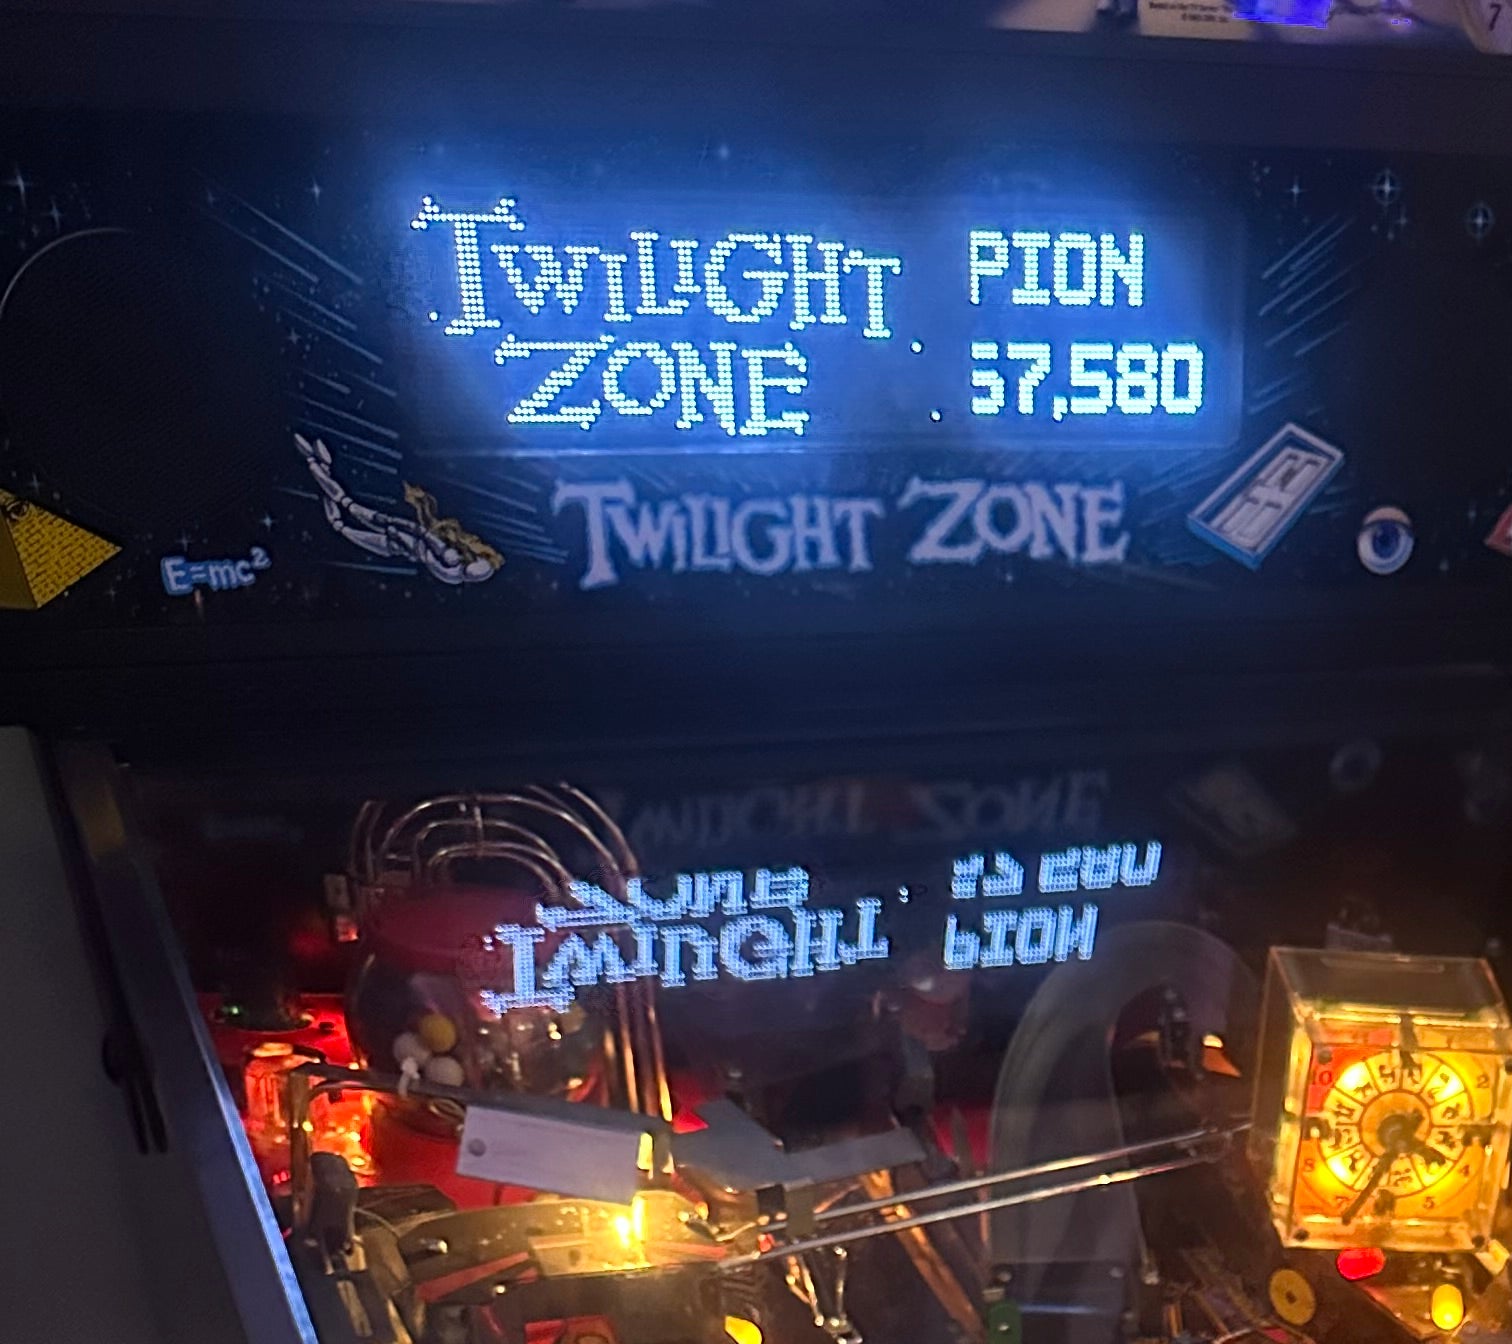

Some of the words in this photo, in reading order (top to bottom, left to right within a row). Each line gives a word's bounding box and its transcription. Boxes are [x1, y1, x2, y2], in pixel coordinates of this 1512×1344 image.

[1485, 4, 1502, 31] 7
[411, 196, 902, 338] TWILIGHT
[969, 231, 1144, 306] PION
[494, 335, 809, 437] ZONE
[552, 478, 886, 589] TWILIGHT
[899, 477, 1131, 566] ZONE
